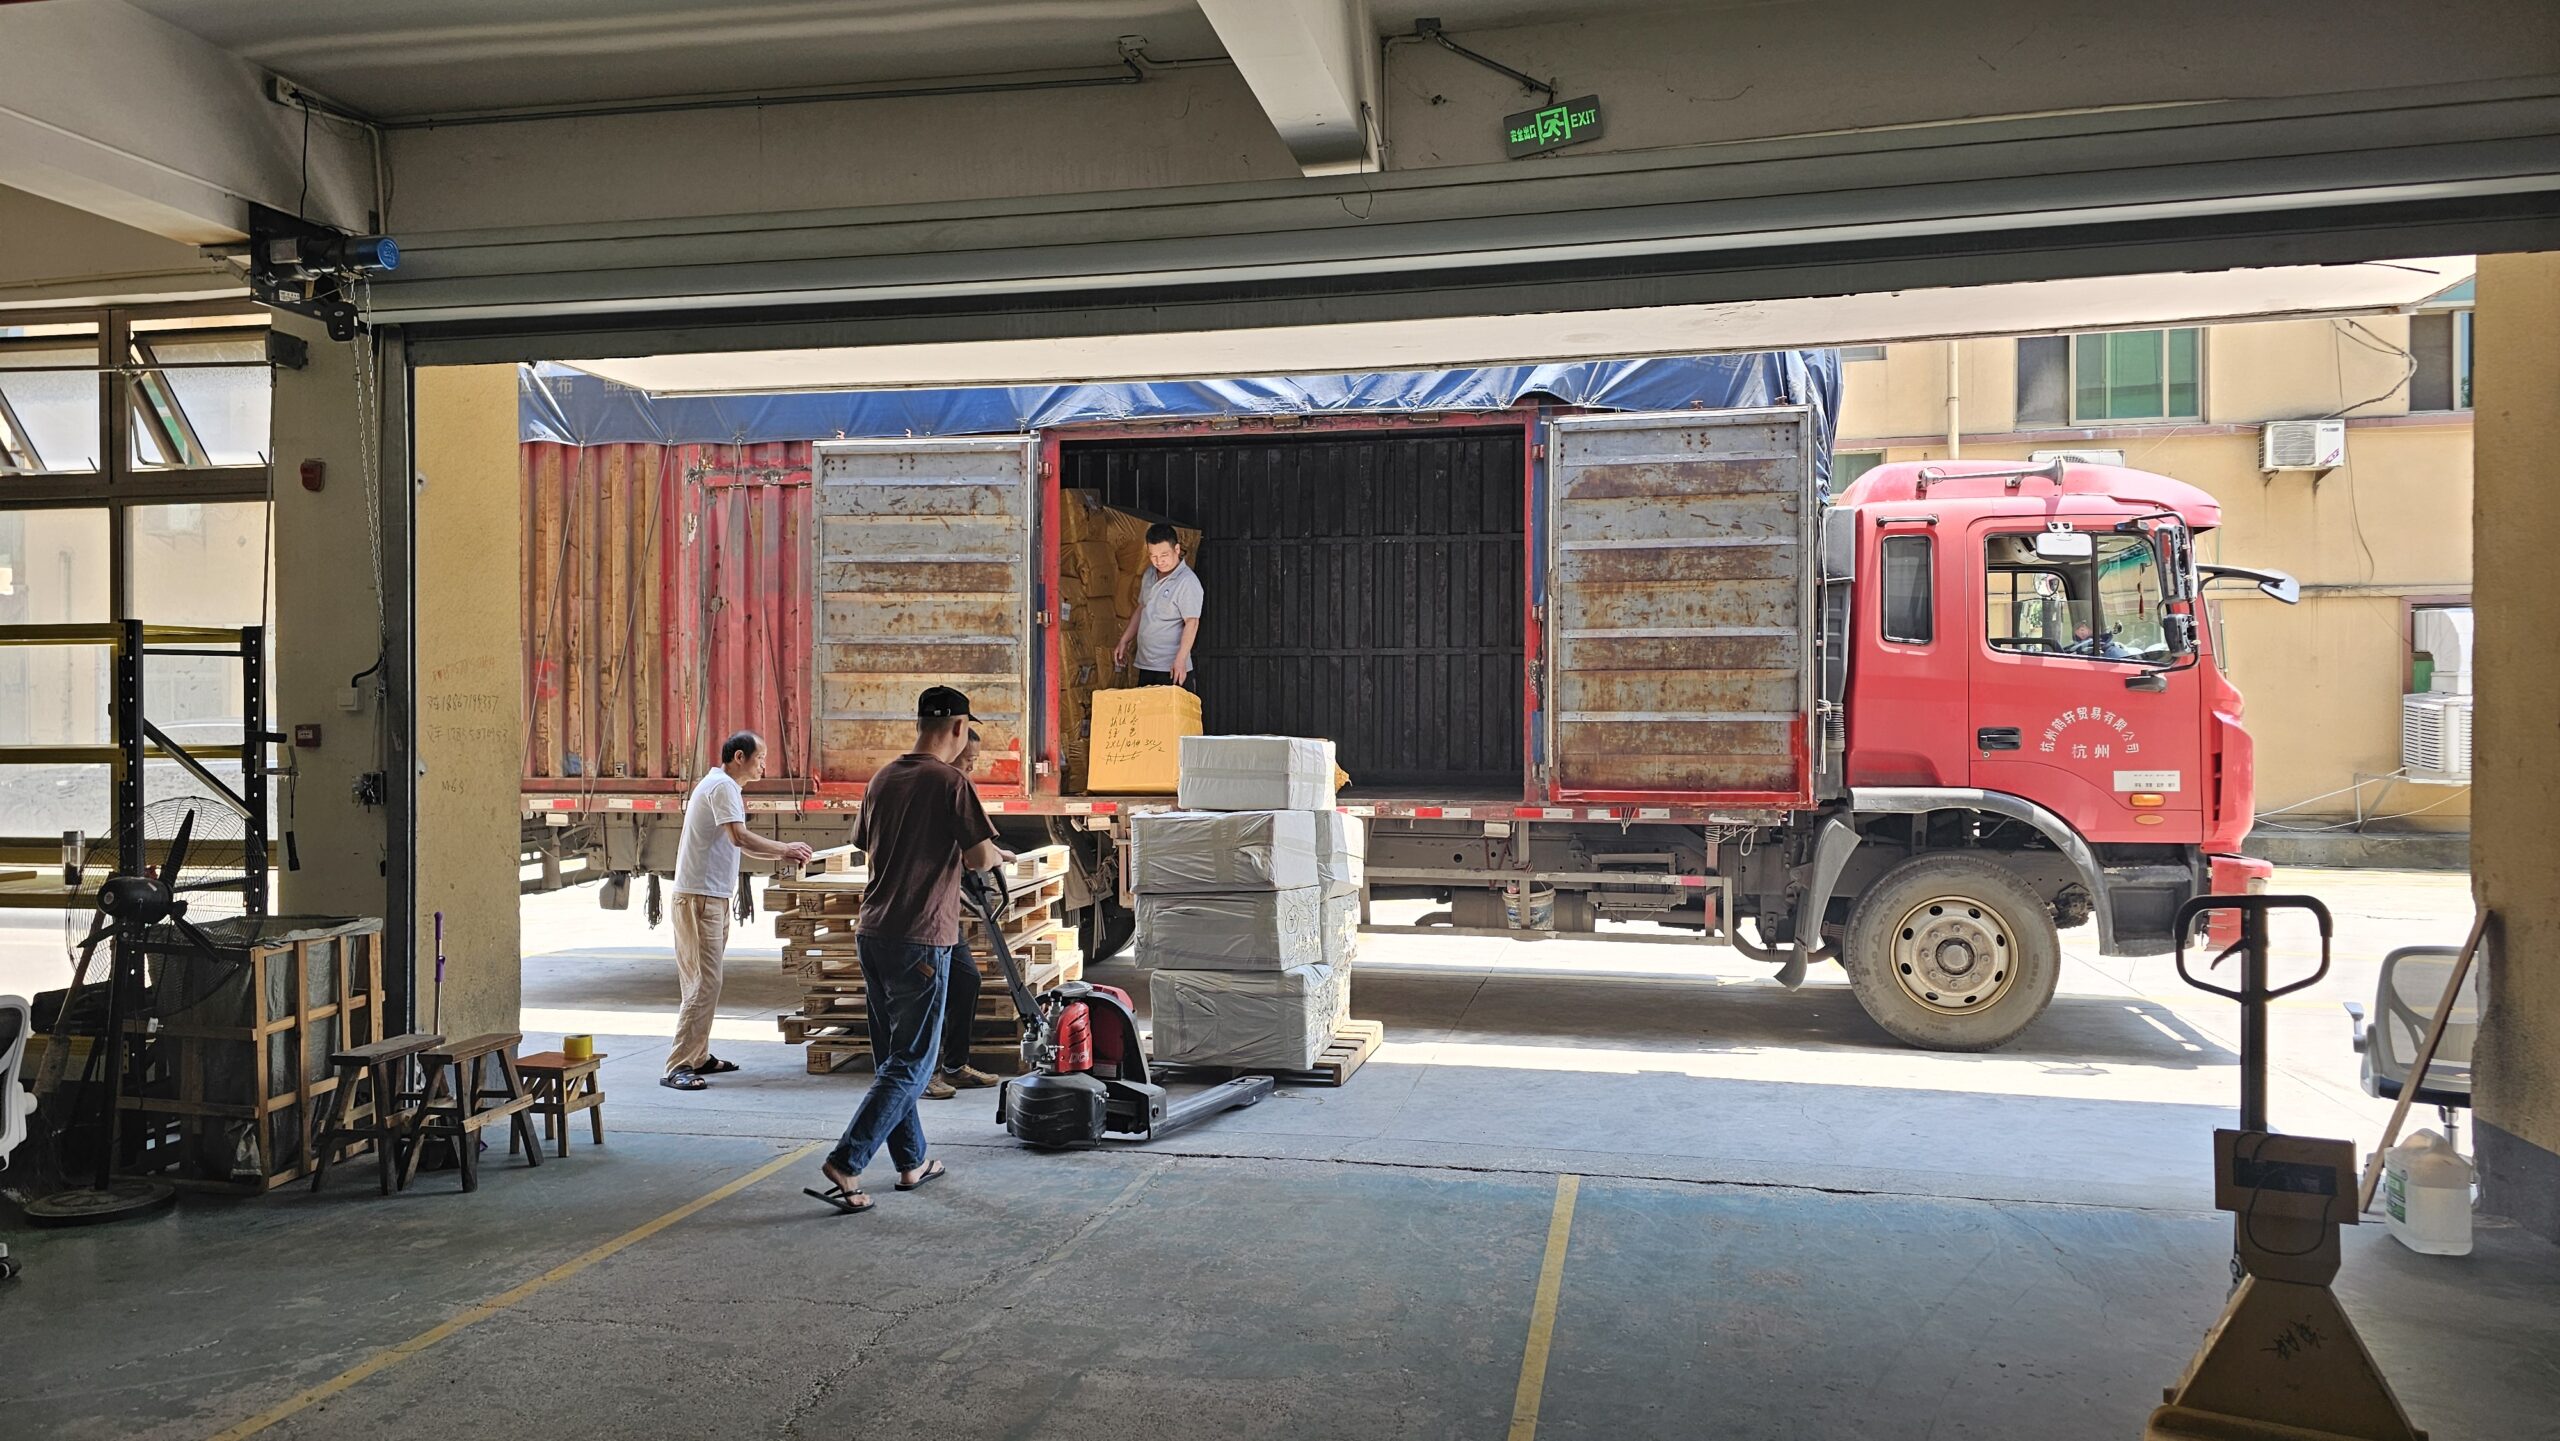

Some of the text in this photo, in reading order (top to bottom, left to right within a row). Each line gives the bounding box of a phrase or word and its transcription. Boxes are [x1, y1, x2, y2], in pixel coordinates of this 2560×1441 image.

[1571, 109, 1596, 128] EXIT
[1510, 124, 1537, 143] 安全出口
[2040, 706, 2139, 753] 杭州鹤轩贸易有限公司
[2072, 743, 2110, 759] 杭州
